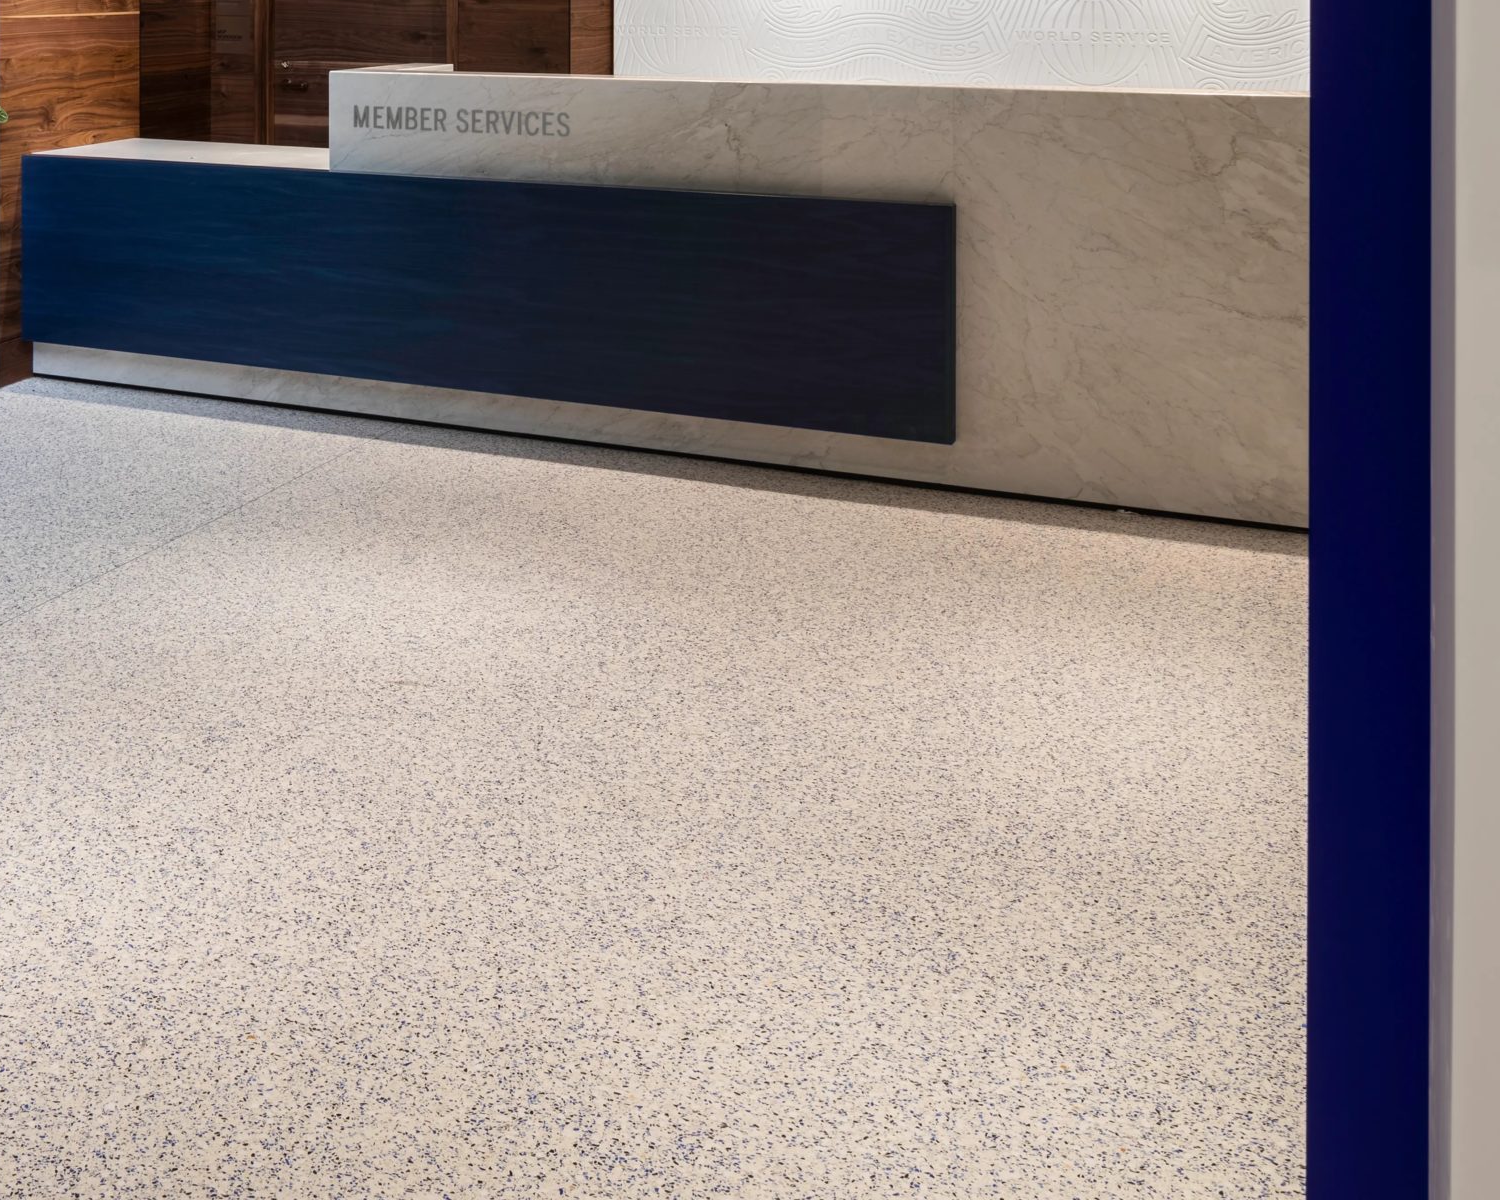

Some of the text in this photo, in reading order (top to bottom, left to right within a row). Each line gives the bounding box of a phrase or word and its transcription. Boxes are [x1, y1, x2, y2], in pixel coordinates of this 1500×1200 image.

[772, 27, 876, 53] AMERCAN
[1015, 30, 1171, 44] WORLD SERVICE
[353, 104, 571, 137] MEMBER SERVICES
